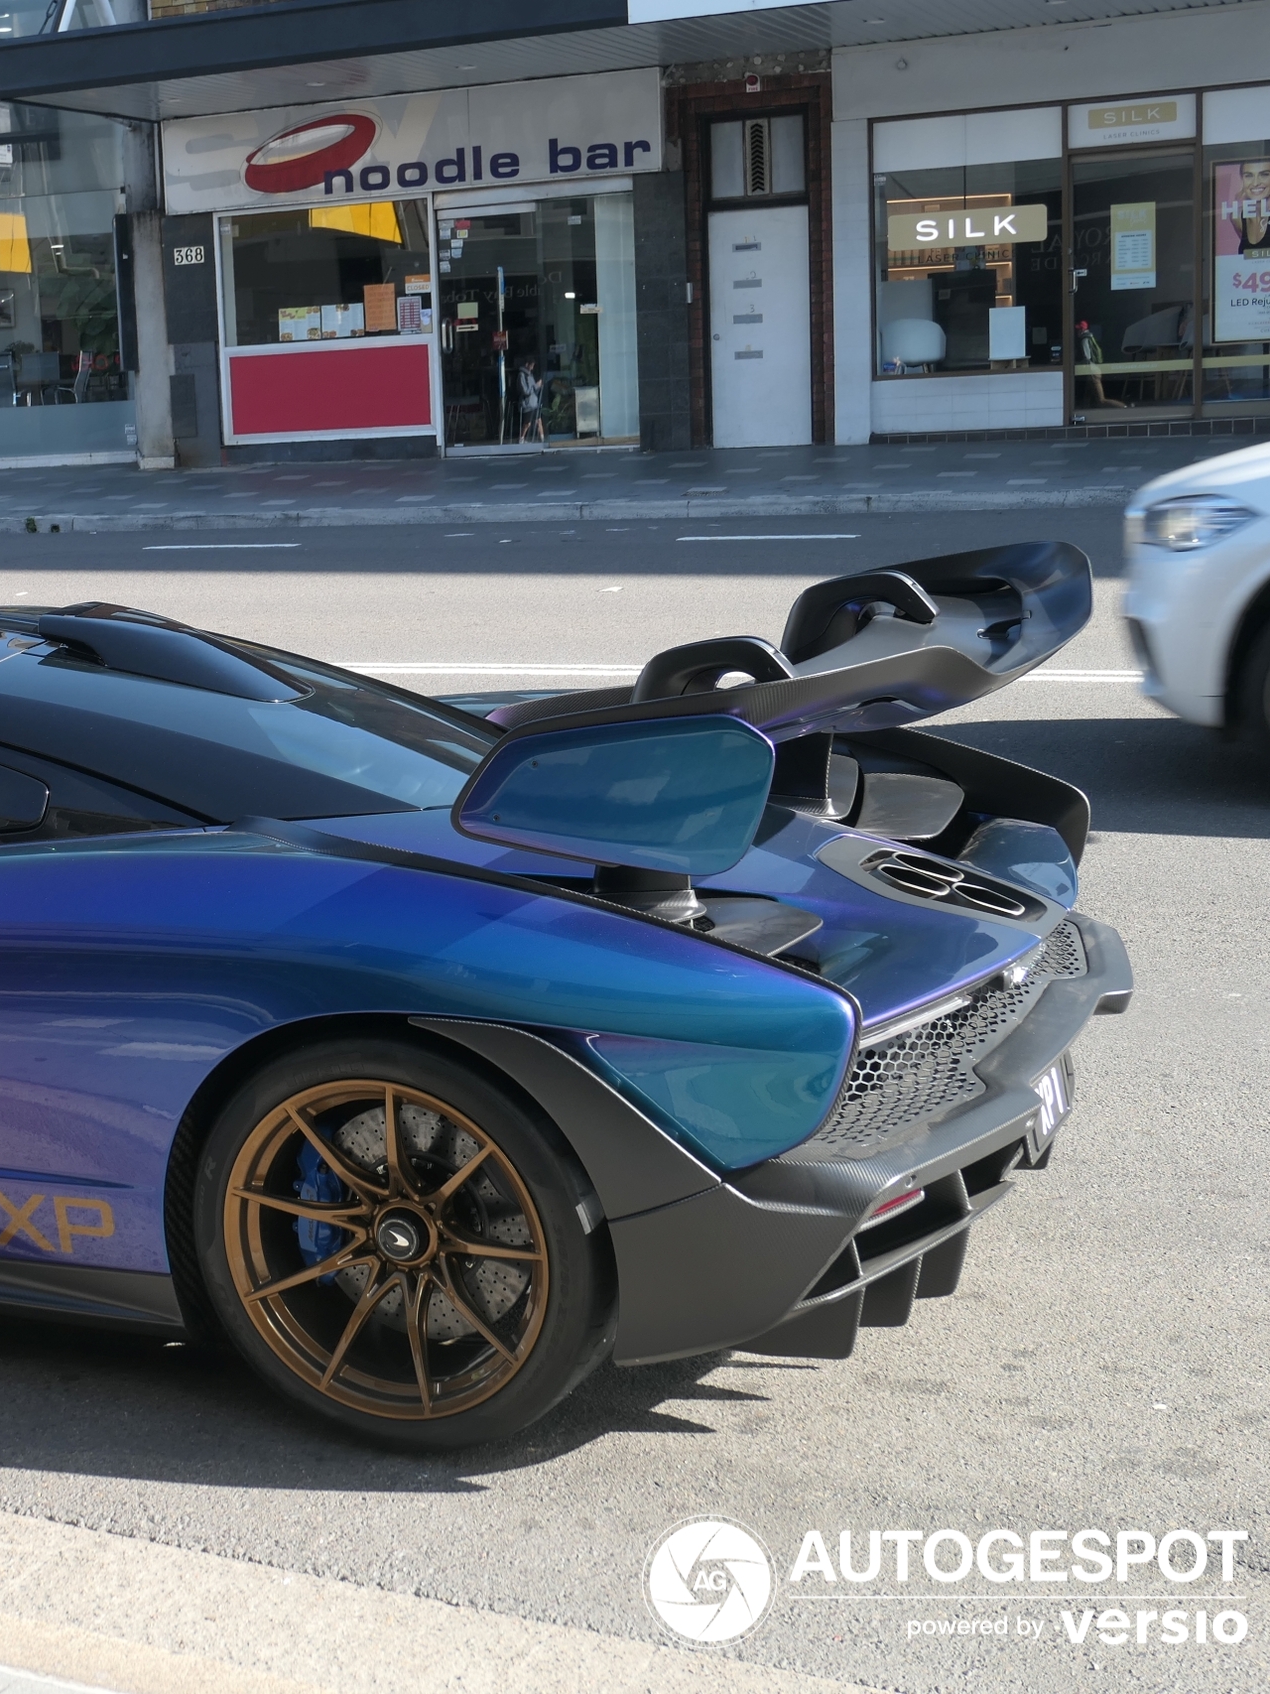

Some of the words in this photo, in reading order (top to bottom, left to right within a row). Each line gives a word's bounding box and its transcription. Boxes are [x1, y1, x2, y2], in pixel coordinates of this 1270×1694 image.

[1104, 107, 1160, 124] SILK
[1103, 132, 1127, 140] LASER
[1130, 129, 1160, 137] CLINICS
[323, 145, 520, 196] noodle
[548, 137, 652, 174] bar
[915, 214, 1018, 242] SILK
[175, 247, 203, 264] 368
[917, 252, 960, 265] LASER
[1230, 297, 1249, 307] LED
